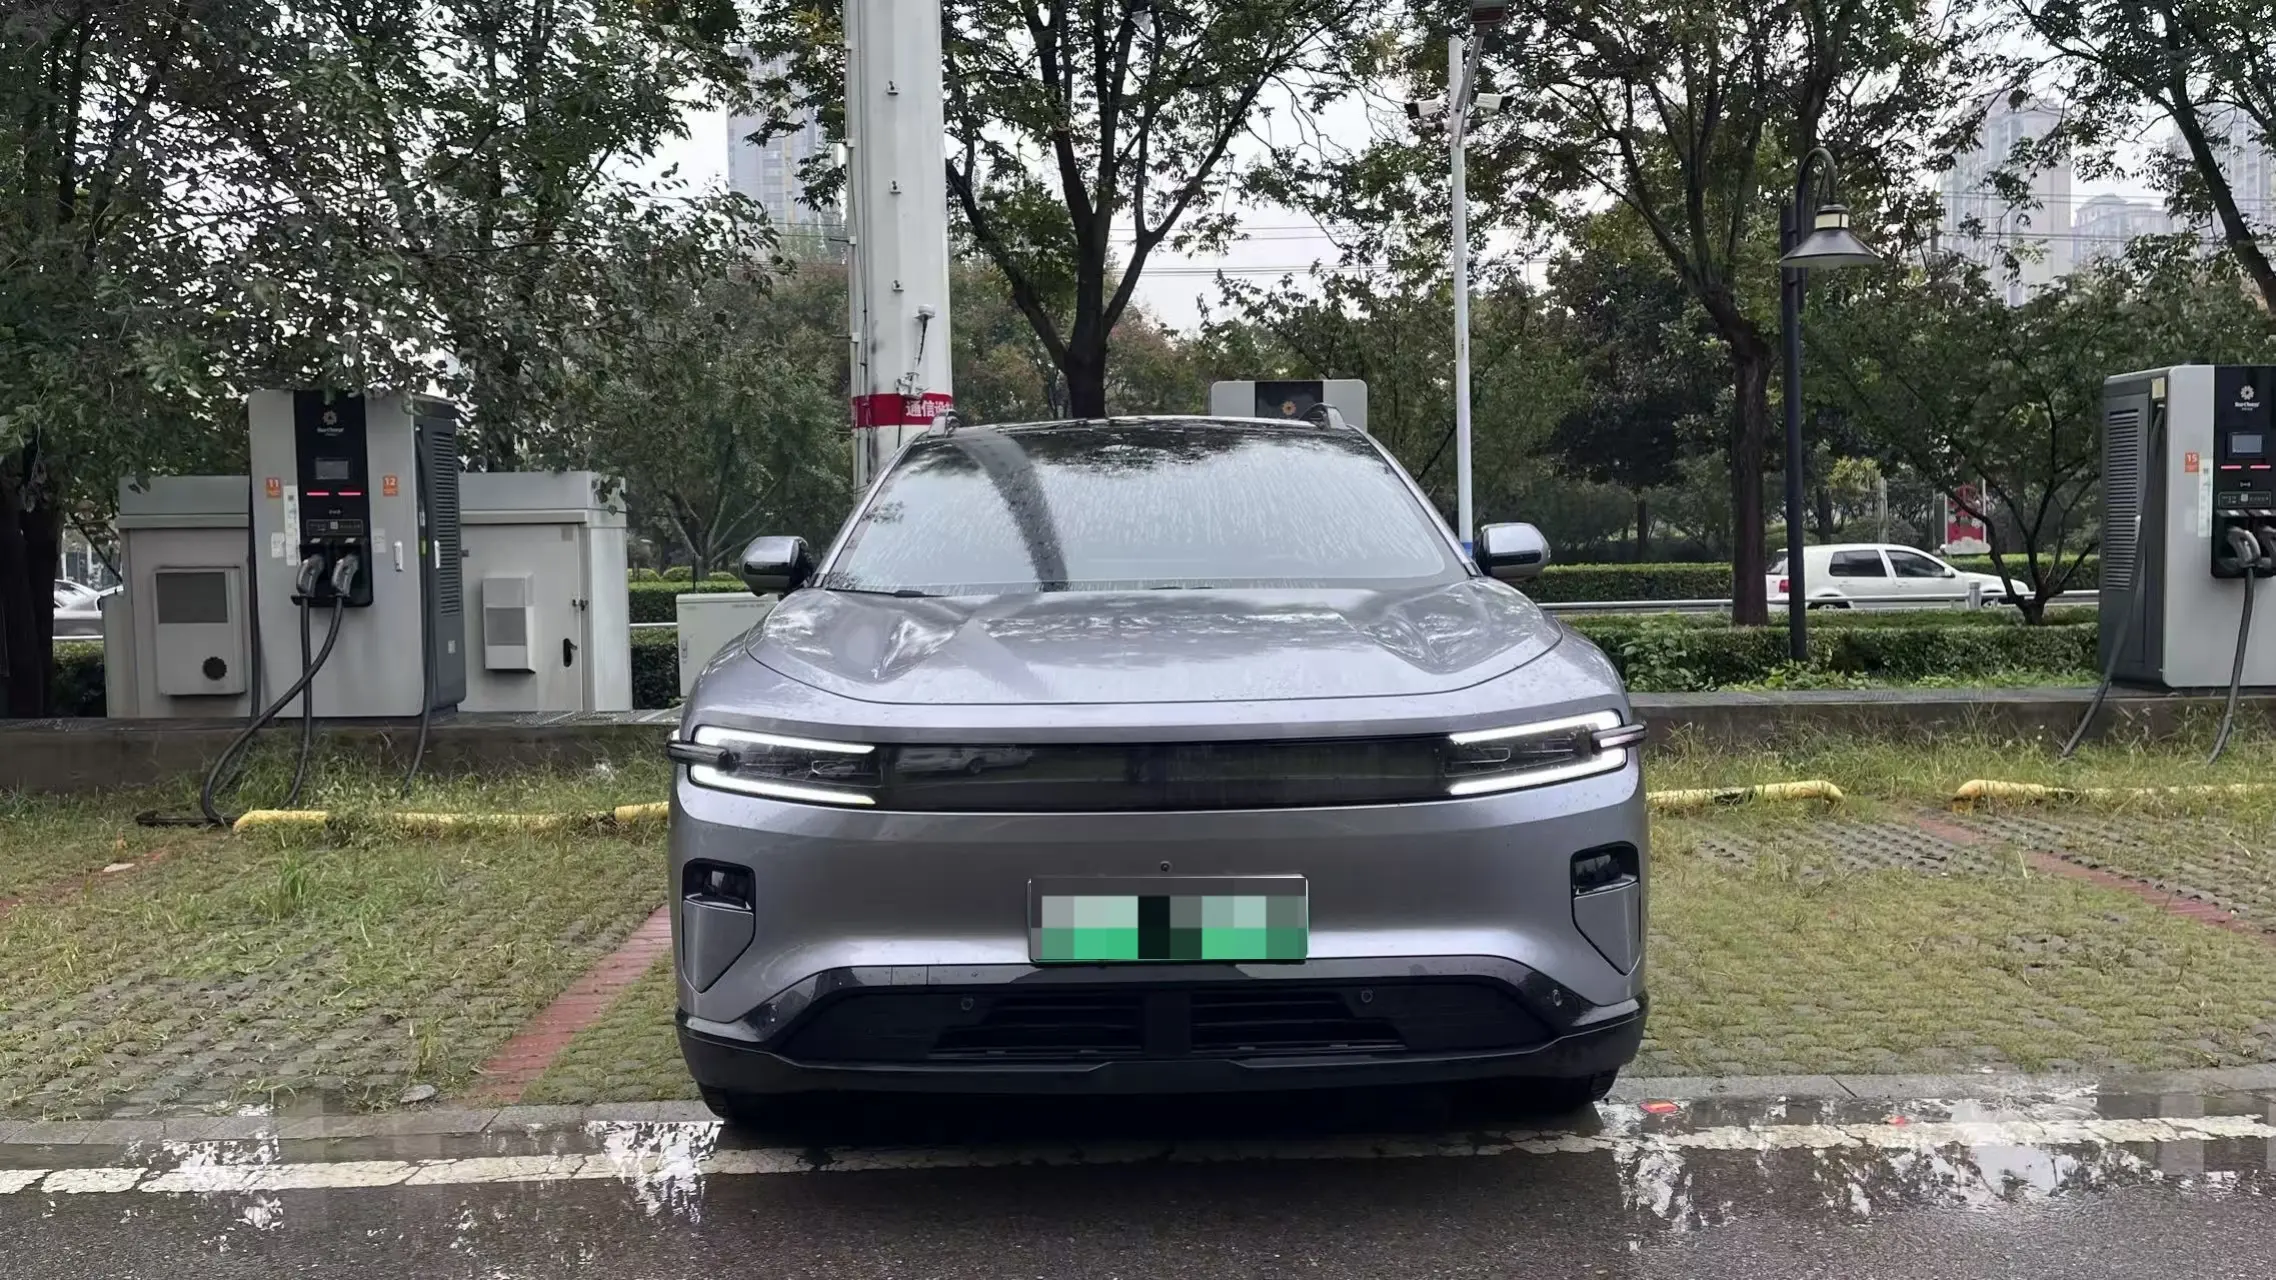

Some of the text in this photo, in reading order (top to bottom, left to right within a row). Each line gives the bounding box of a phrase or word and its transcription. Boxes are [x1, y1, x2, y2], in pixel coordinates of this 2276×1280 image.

[906, 400, 953, 417] 通信设
[269, 479, 279, 487] 11
[385, 477, 396, 486] 12
